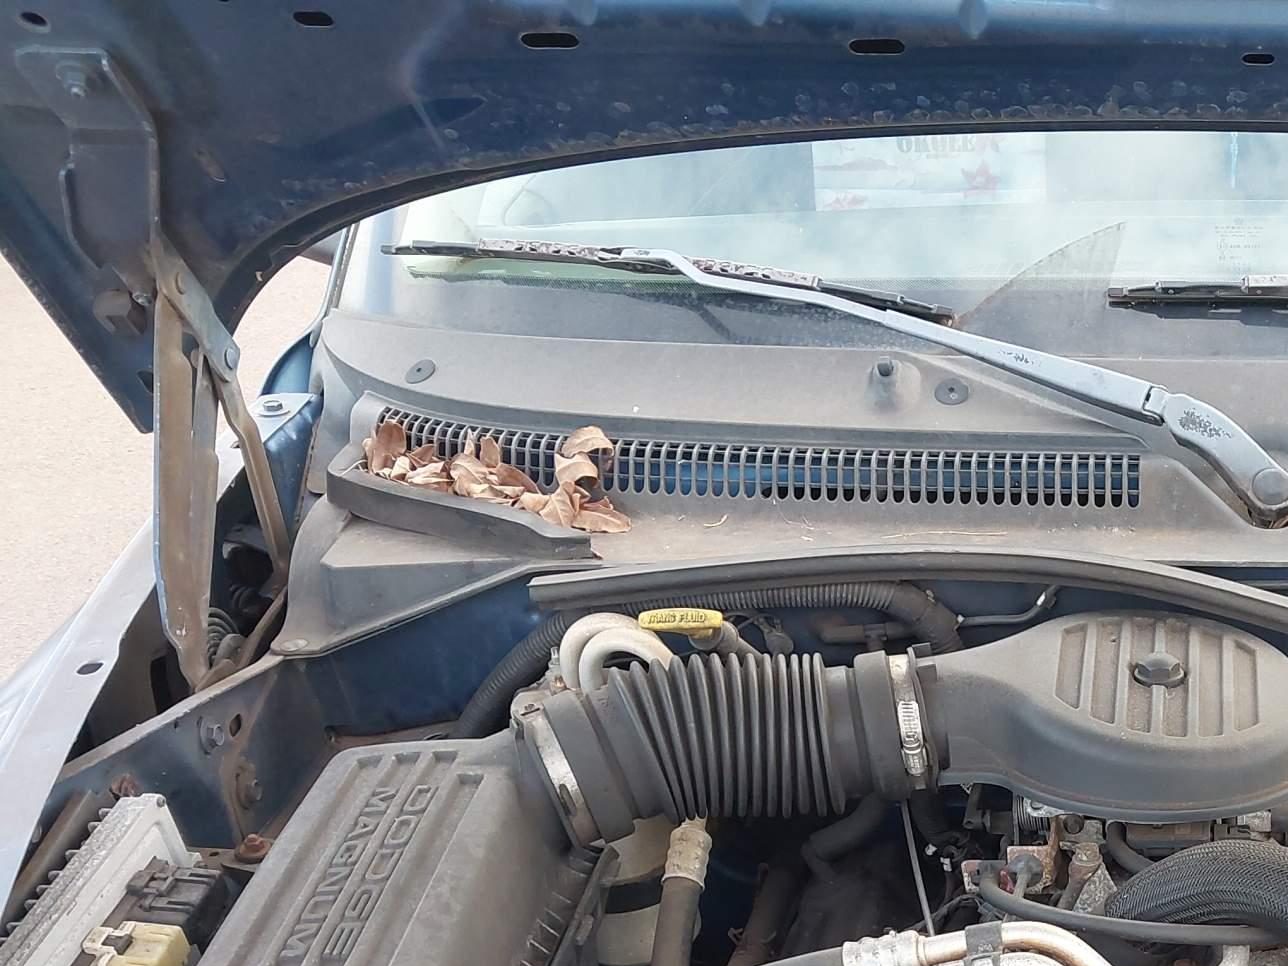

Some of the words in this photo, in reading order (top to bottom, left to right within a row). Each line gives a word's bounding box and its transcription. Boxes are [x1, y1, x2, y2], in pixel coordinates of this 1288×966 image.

[680, 611, 706, 623] FLUID
[279, 786, 400, 958] MAGNUM
[322, 784, 438, 959] DODGE
